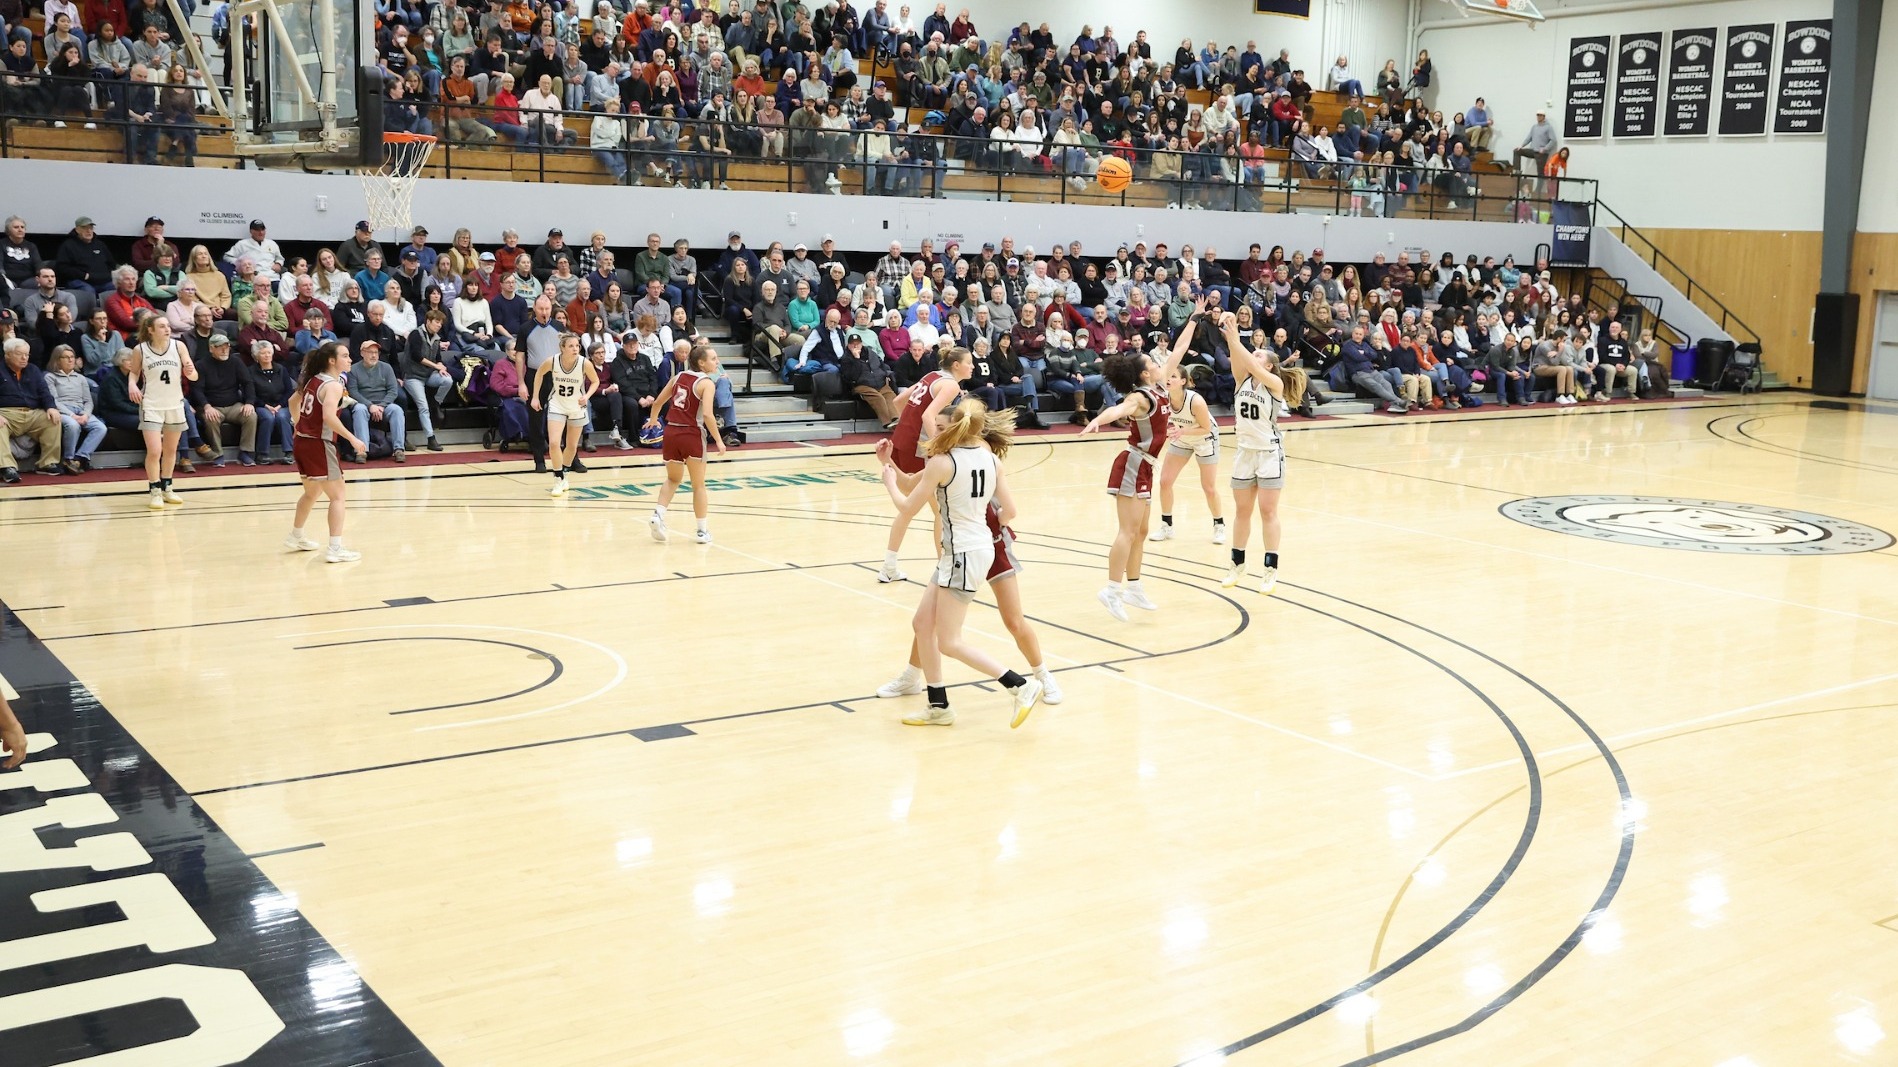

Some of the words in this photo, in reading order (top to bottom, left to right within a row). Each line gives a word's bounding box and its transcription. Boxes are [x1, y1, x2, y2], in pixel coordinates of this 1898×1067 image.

[1730, 31, 1770, 47] BOWDOIN
[1788, 27, 1831, 43] BOWDOIN
[1572, 42, 1607, 56] BOWDOIN
[1622, 39, 1658, 54] BOWDOIN
[1674, 35, 1712, 50] BOWDOIN
[1727, 69, 1767, 77] BASKETBALL
[1784, 66, 1827, 74] BASKETBALL
[1725, 91, 1764, 99] Tournament
[1782, 88, 1822, 96] Champions
[1568, 97, 1602, 105] Champions
[1619, 95, 1653, 104] Champions
[1556, 225, 1590, 233] CHAMPIONS
[148, 360, 178, 370] BOWDOIN
[978, 362, 990, 376] B
[160, 370, 170, 384] 4
[559, 385, 574, 396] 23
[673, 385, 688, 408] 2
[908, 382, 928, 406] 22
[300, 392, 314, 415] 13
[1240, 402, 1260, 420] 20
[971, 470, 985, 498] 11
